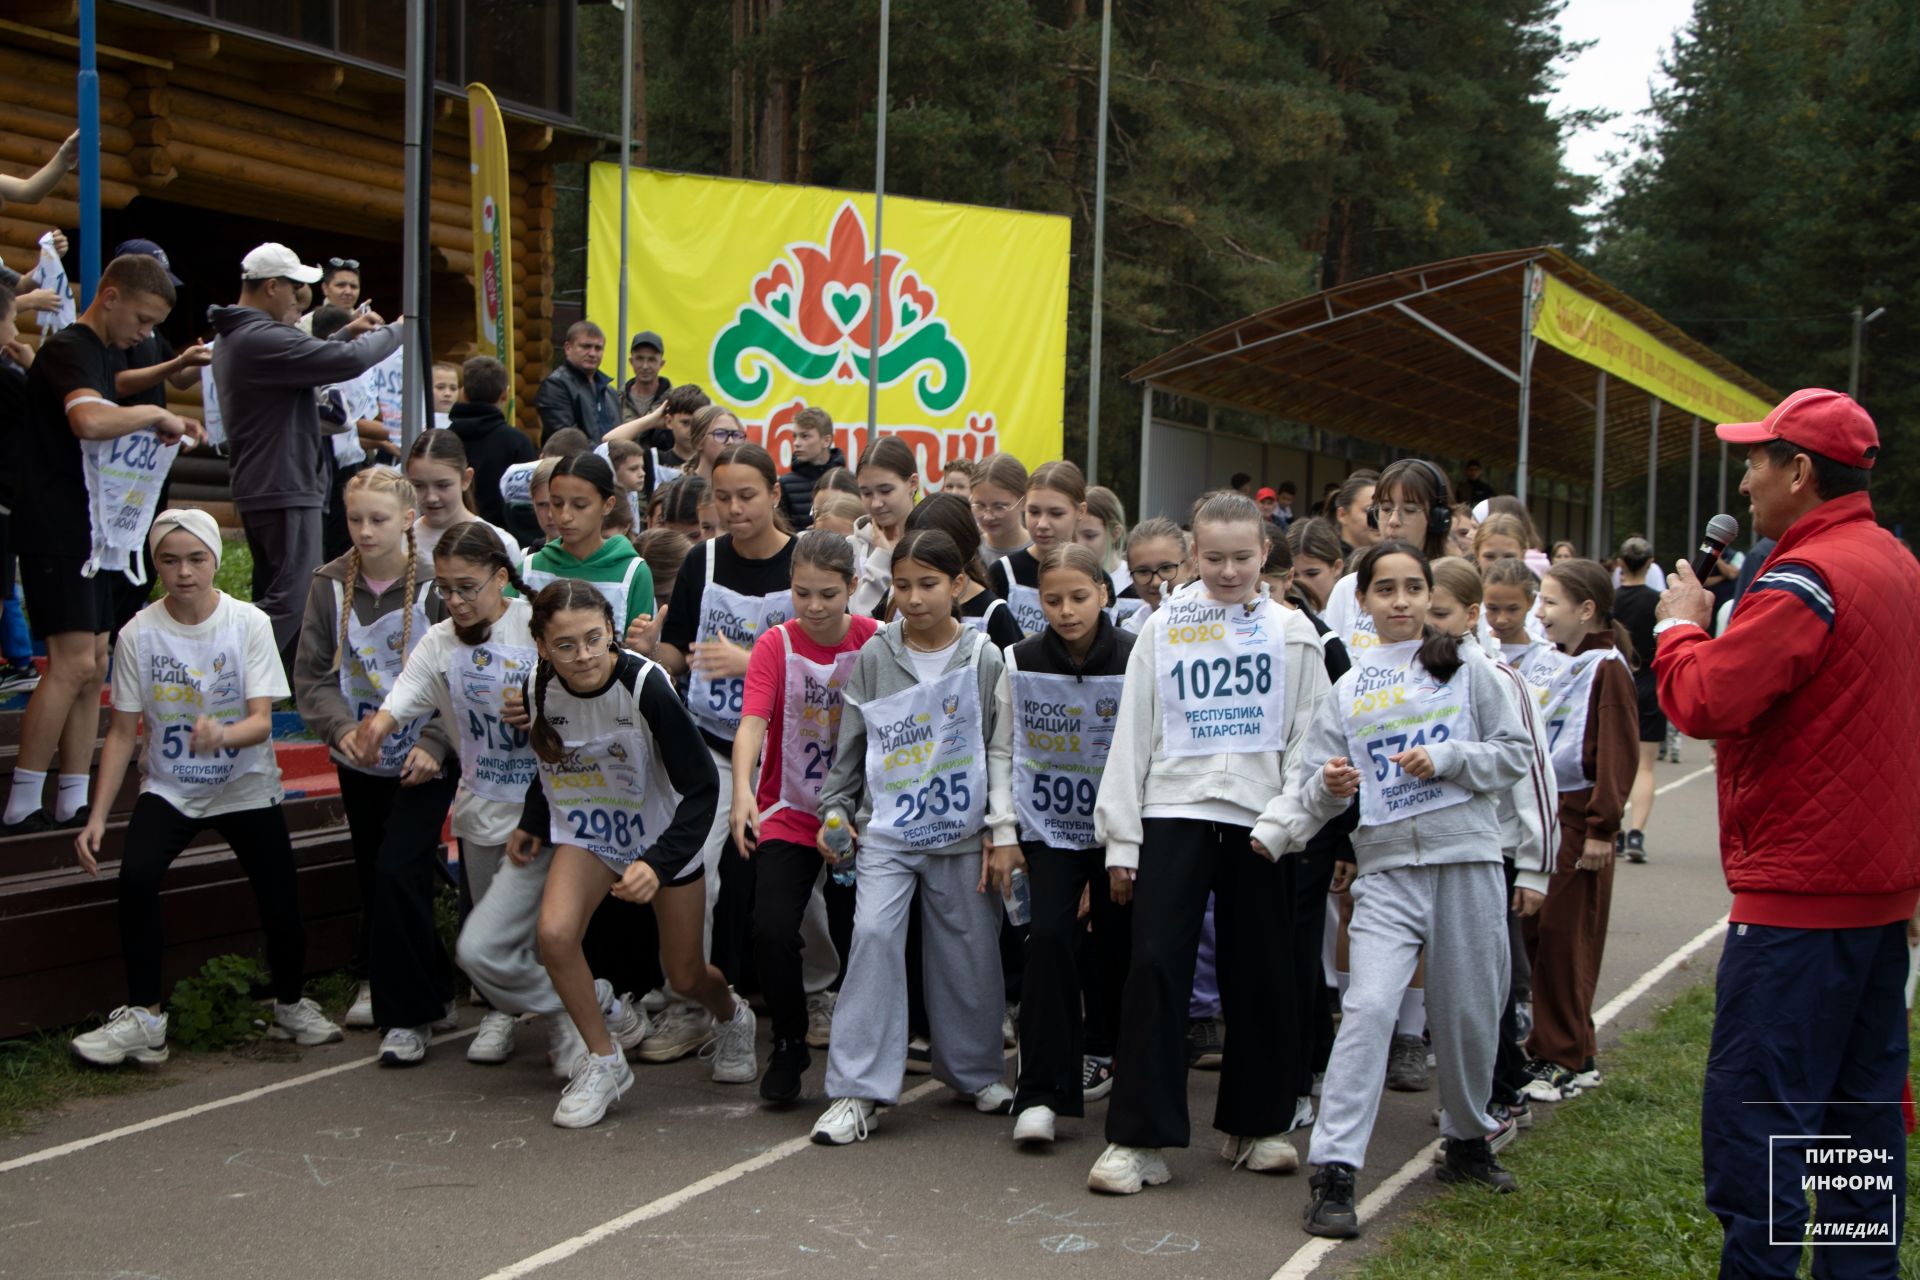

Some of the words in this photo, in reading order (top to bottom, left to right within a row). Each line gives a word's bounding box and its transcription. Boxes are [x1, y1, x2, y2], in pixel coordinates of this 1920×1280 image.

[1167, 608, 1226, 625] НАЦИИ
[1168, 624, 1225, 645] 2020
[1171, 653, 1272, 700] 10258
[1024, 700, 1066, 717] КРОСС
[1185, 706, 1264, 723] РЕСПУБЛИКА
[876, 714, 917, 740] КРОСС
[1025, 716, 1081, 733] НАЦИИ
[1191, 722, 1260, 738] ТАТАРСТАН
[882, 725, 933, 754] НАЦИИ
[1386, 786, 1444, 812] ТАТАРСТАН
[567, 808, 645, 847] 2981
[903, 819, 966, 840] РЕСПУБЛИКА
[1045, 818, 1095, 831] РЕСПУБЛИ
[910, 832, 961, 848] ТАТАРСТАН
[1051, 831, 1096, 843] ТАТАРСТА
